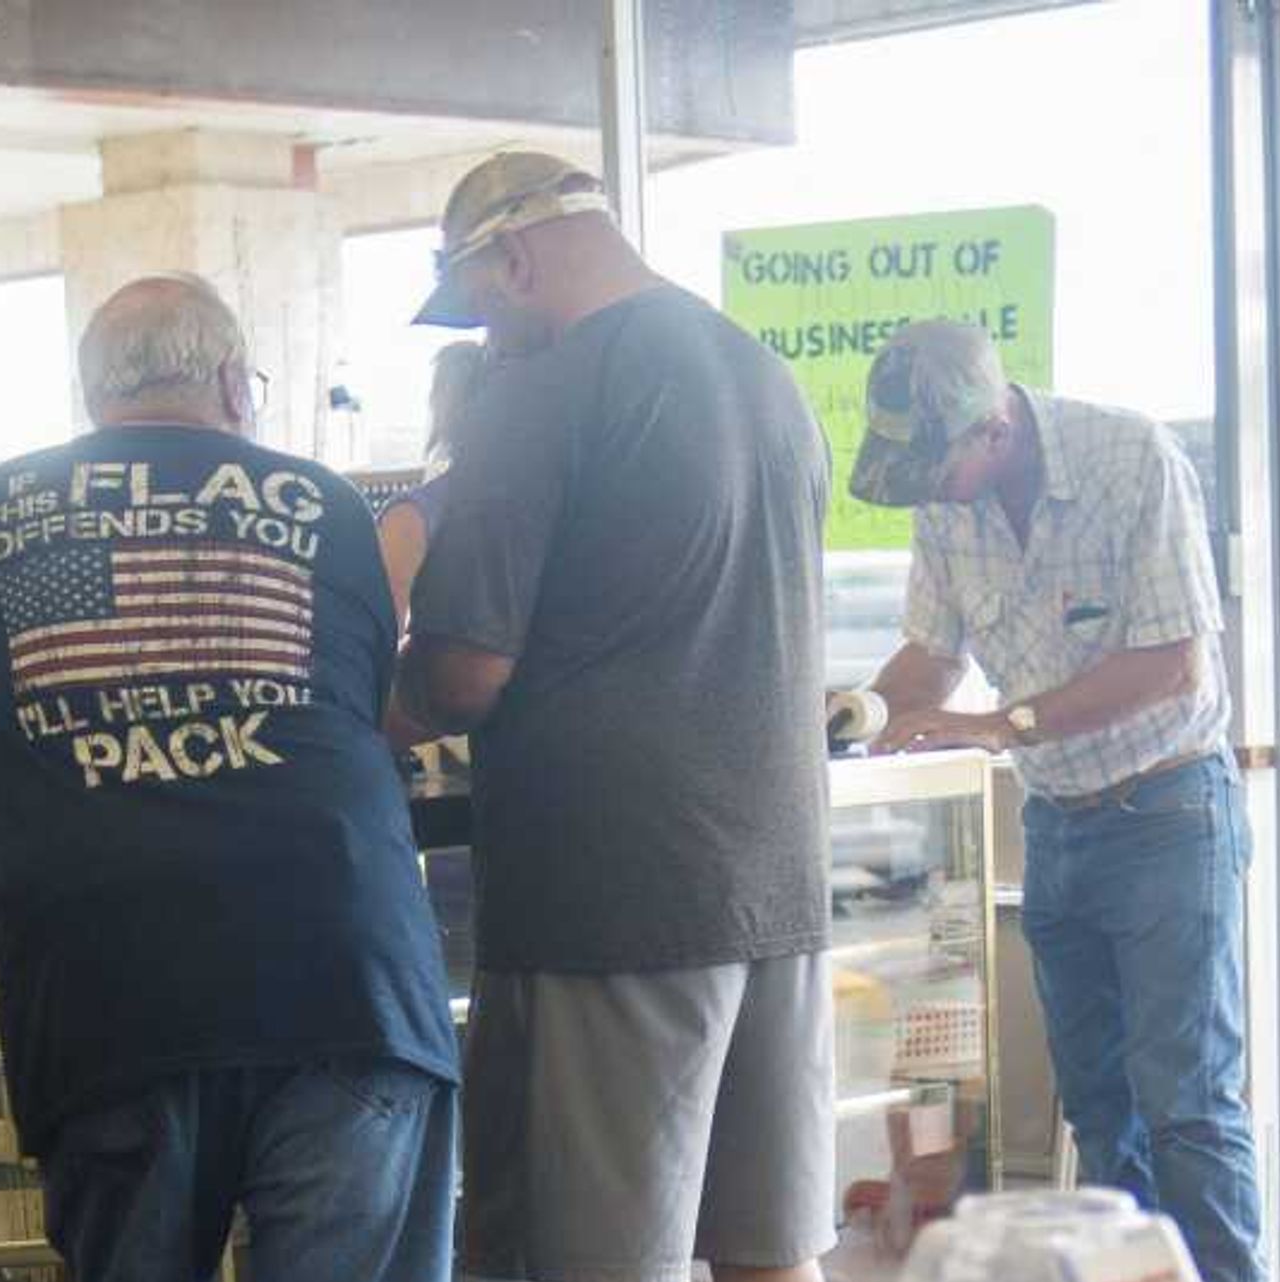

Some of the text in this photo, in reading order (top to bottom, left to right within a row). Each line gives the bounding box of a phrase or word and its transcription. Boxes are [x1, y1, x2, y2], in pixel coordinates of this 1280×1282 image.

[742, 239, 1001, 285] GOING OUT OF
[759, 316, 910, 359] BUSINES
[9, 472, 37, 497] IF
[69, 462, 324, 523] FLAG
[230, 510, 319, 560] YOU
[17, 679, 313, 741] I'LL HELP YOU
[74, 711, 285, 788] PACK
